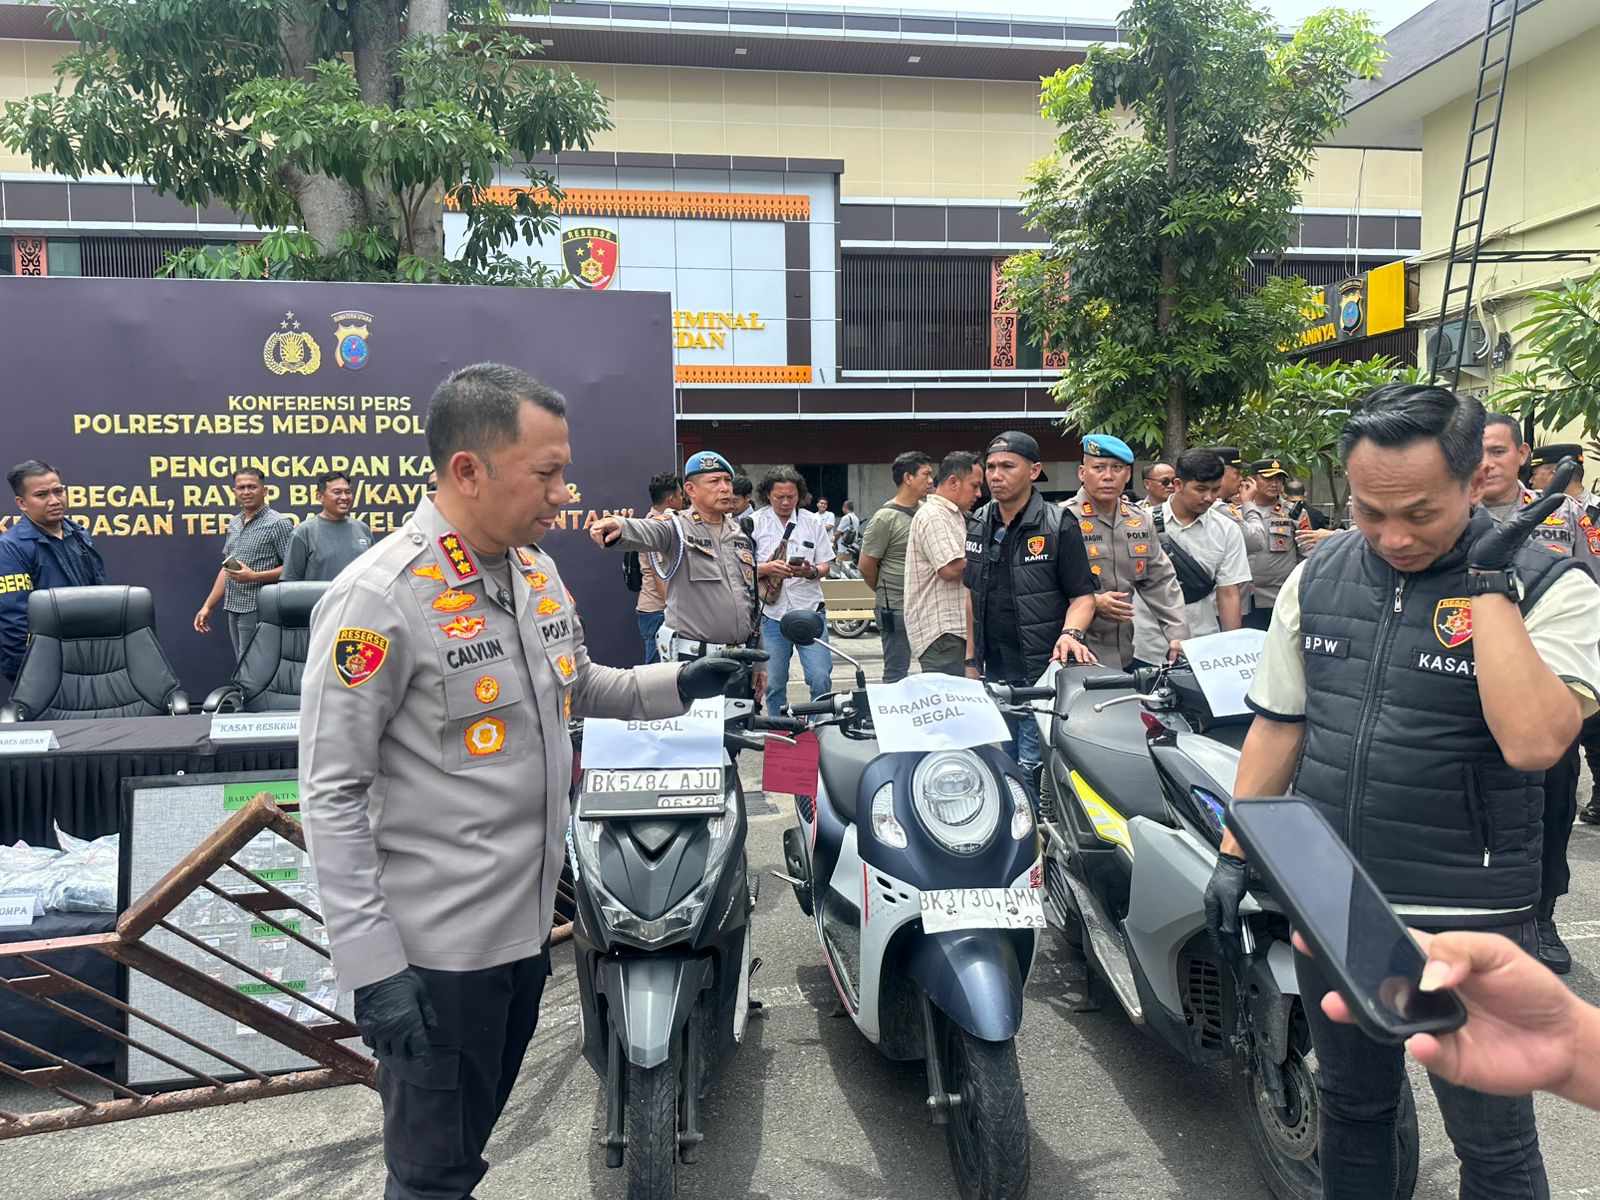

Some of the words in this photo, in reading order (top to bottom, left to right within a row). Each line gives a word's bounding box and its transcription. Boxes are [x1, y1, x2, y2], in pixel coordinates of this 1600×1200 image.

[567, 229, 611, 239] RESERSE
[673, 311, 766, 330] IMINAL
[673, 332, 725, 349] DAN
[1297, 322, 1337, 348] ANNYA
[228, 395, 355, 412] KONFERENSI
[361, 396, 412, 411] PERS
[74, 414, 264, 434] POLRESTABES
[272, 415, 367, 434] MEDAN
[375, 415, 425, 434] POL
[399, 456, 436, 476] KA
[62, 484, 175, 512] BEGAL,
[183, 484, 280, 507] RAYP
[565, 482, 581, 503] &
[1126, 531, 1149, 540] POLRI
[1531, 529, 1571, 542] POLRI
[1024, 553, 1049, 562] KANIT
[0, 573, 34, 595] SERS
[340, 630, 386, 649] RESERSE
[446, 638, 504, 669] CALVIJN
[878, 694, 941, 715] BARANG
[945, 693, 989, 704] BUKTI
[685, 710, 718, 718] KTI
[912, 706, 965, 727] BEGAL
[221, 723, 255, 732] KASAT
[256, 722, 297, 731] RESKRIM
[627, 720, 684, 731] BEGAL
[0, 738, 18, 746] ABES
[680, 772, 717, 789] AJU
[258, 871, 276, 879] NIT
[1004, 888, 1040, 906] AMK
[0, 906, 27, 915] OMPA
[236, 984, 269, 993] POLSEK
